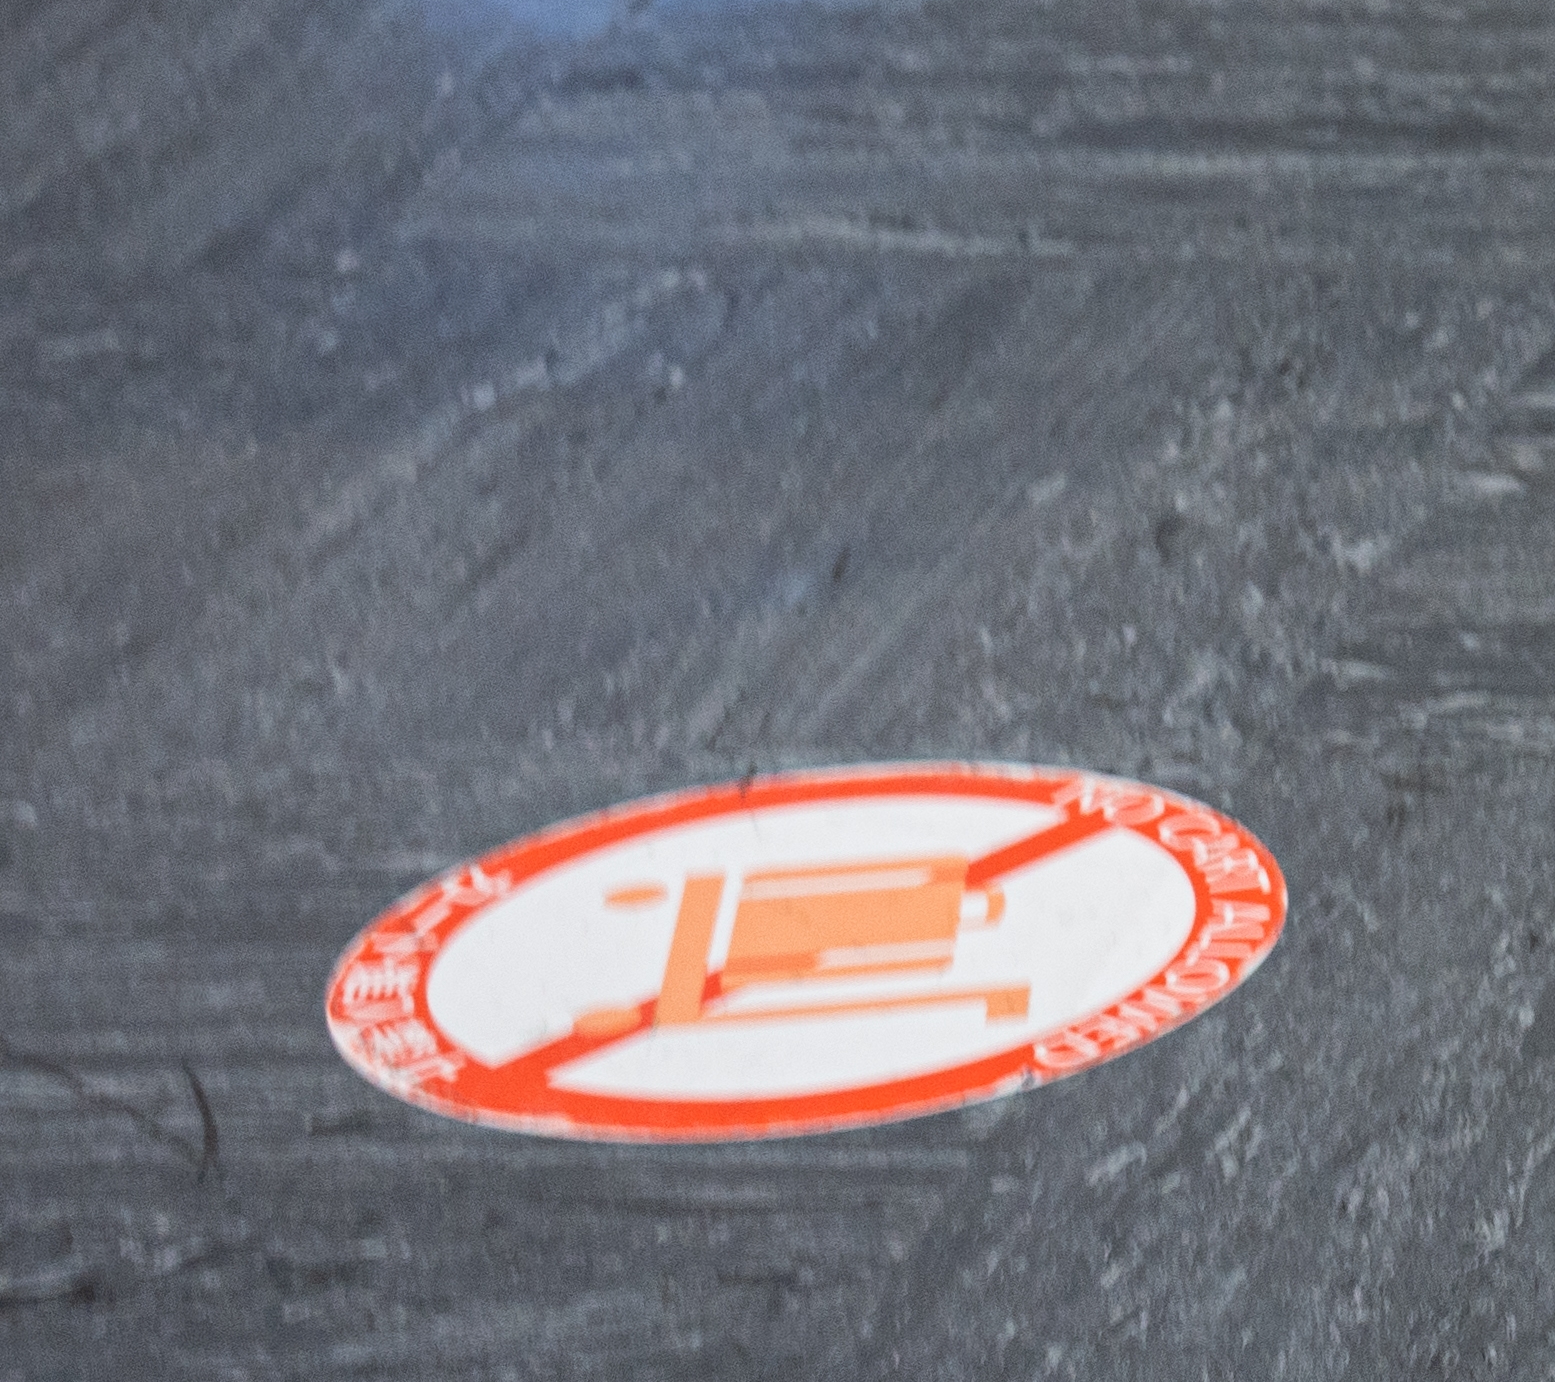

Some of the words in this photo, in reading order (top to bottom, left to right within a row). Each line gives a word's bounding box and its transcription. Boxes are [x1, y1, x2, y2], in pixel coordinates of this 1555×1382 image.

[1051, 777, 1166, 826] NO
[1157, 810, 1270, 895] CART
[1032, 898, 1271, 1069] ALLOWED
